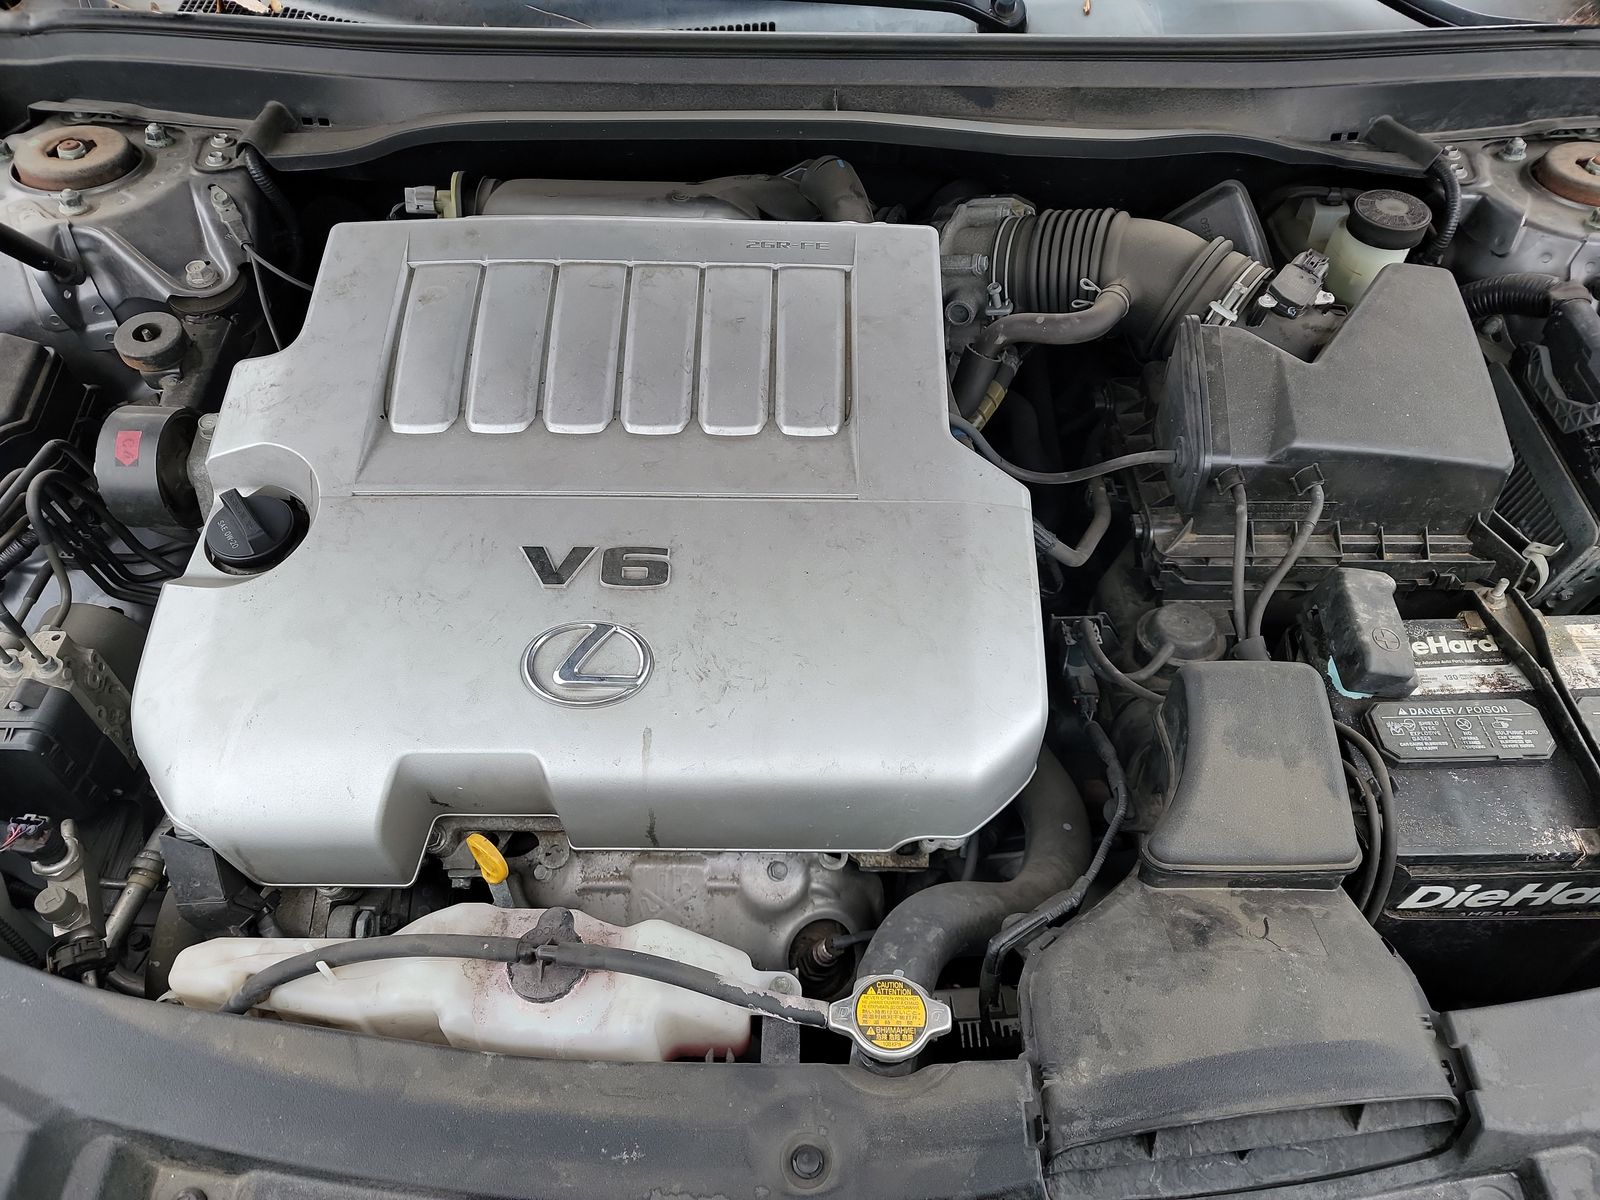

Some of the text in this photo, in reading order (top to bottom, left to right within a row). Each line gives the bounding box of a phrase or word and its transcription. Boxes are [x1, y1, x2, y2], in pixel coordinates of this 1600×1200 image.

[746, 239, 830, 250] 2GR-FE
[217, 519, 240, 549] SAE 0W-20
[518, 545, 671, 590] V6
[1410, 635, 1499, 655] eHard
[1408, 706, 1455, 716] DANGER
[1466, 705, 1509, 714] POISON
[1396, 881, 1600, 909] DieHa
[876, 981, 904, 989] CAUTION
[876, 988, 912, 996] ATTENTION
